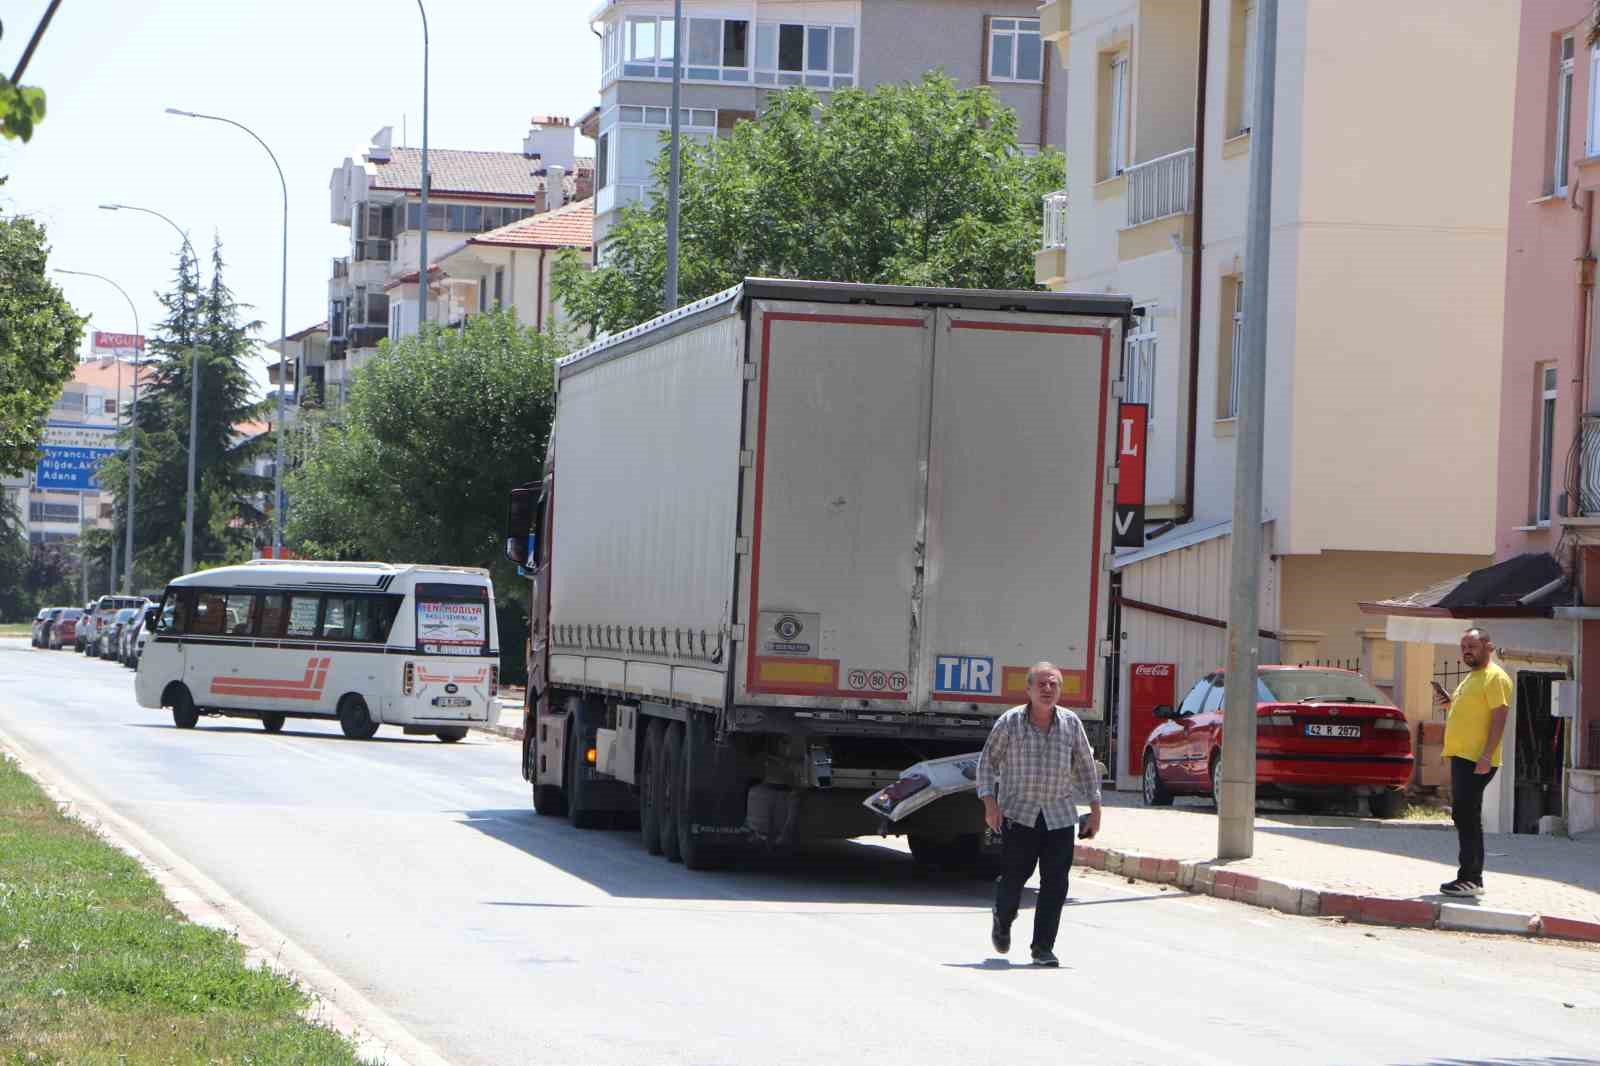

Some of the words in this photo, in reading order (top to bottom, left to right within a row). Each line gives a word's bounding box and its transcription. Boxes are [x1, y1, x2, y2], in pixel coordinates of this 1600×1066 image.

[43, 471, 77, 481] Adana
[939, 656, 990, 690] TIR
[1136, 664, 1168, 676] Coca-Cola
[853, 675, 864, 686] 70
[892, 677, 905, 688] TR
[1310, 725, 1321, 735] 42
